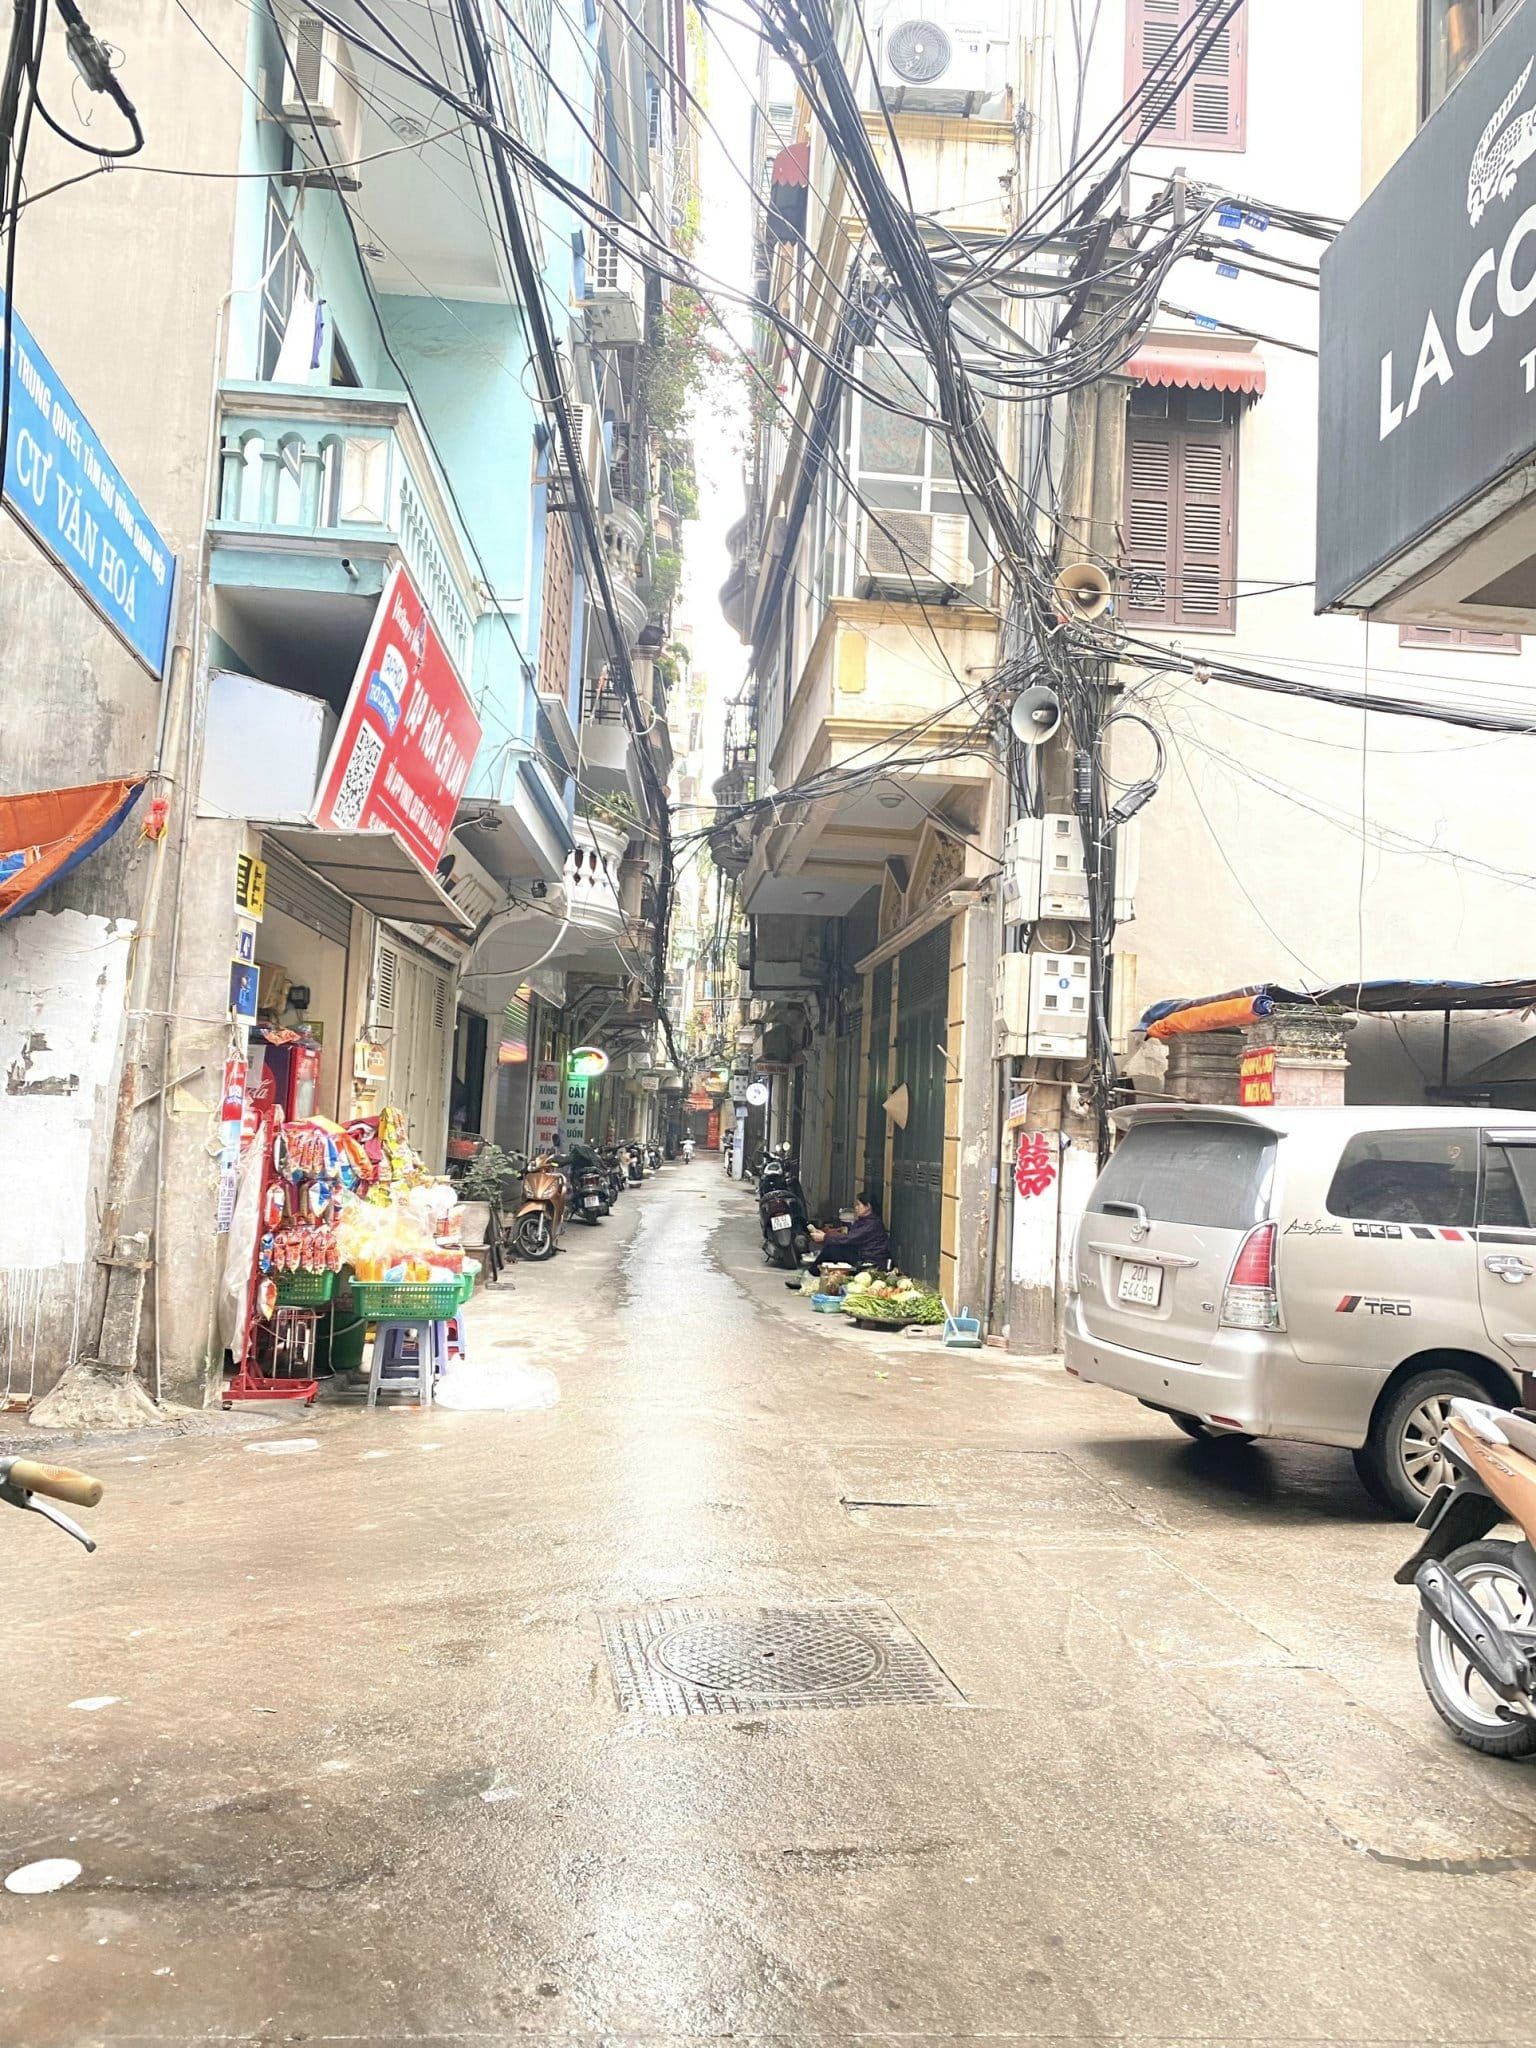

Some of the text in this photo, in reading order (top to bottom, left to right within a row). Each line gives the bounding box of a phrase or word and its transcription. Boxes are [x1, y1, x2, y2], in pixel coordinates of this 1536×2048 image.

[18, 345, 51, 421] TRUNG
[52, 401, 82, 462] QUYẾT
[16, 428, 140, 623] CƯ VĂN HOÁ
[403, 678, 429, 746] TẠP
[418, 704, 450, 766] HOÁ
[435, 732, 457, 796] CHỊ
[446, 754, 468, 801] LAN
[539, 1084, 558, 1095] XÔNG
[568, 1083, 586, 1099] CẮT
[568, 1102, 585, 1116] TÓC
[567, 1127, 584, 1138] UỐN
[1353, 1223, 1402, 1238] HKS
[1132, 1265, 1148, 1282] 20A
[1364, 1302, 1411, 1316] TRD
